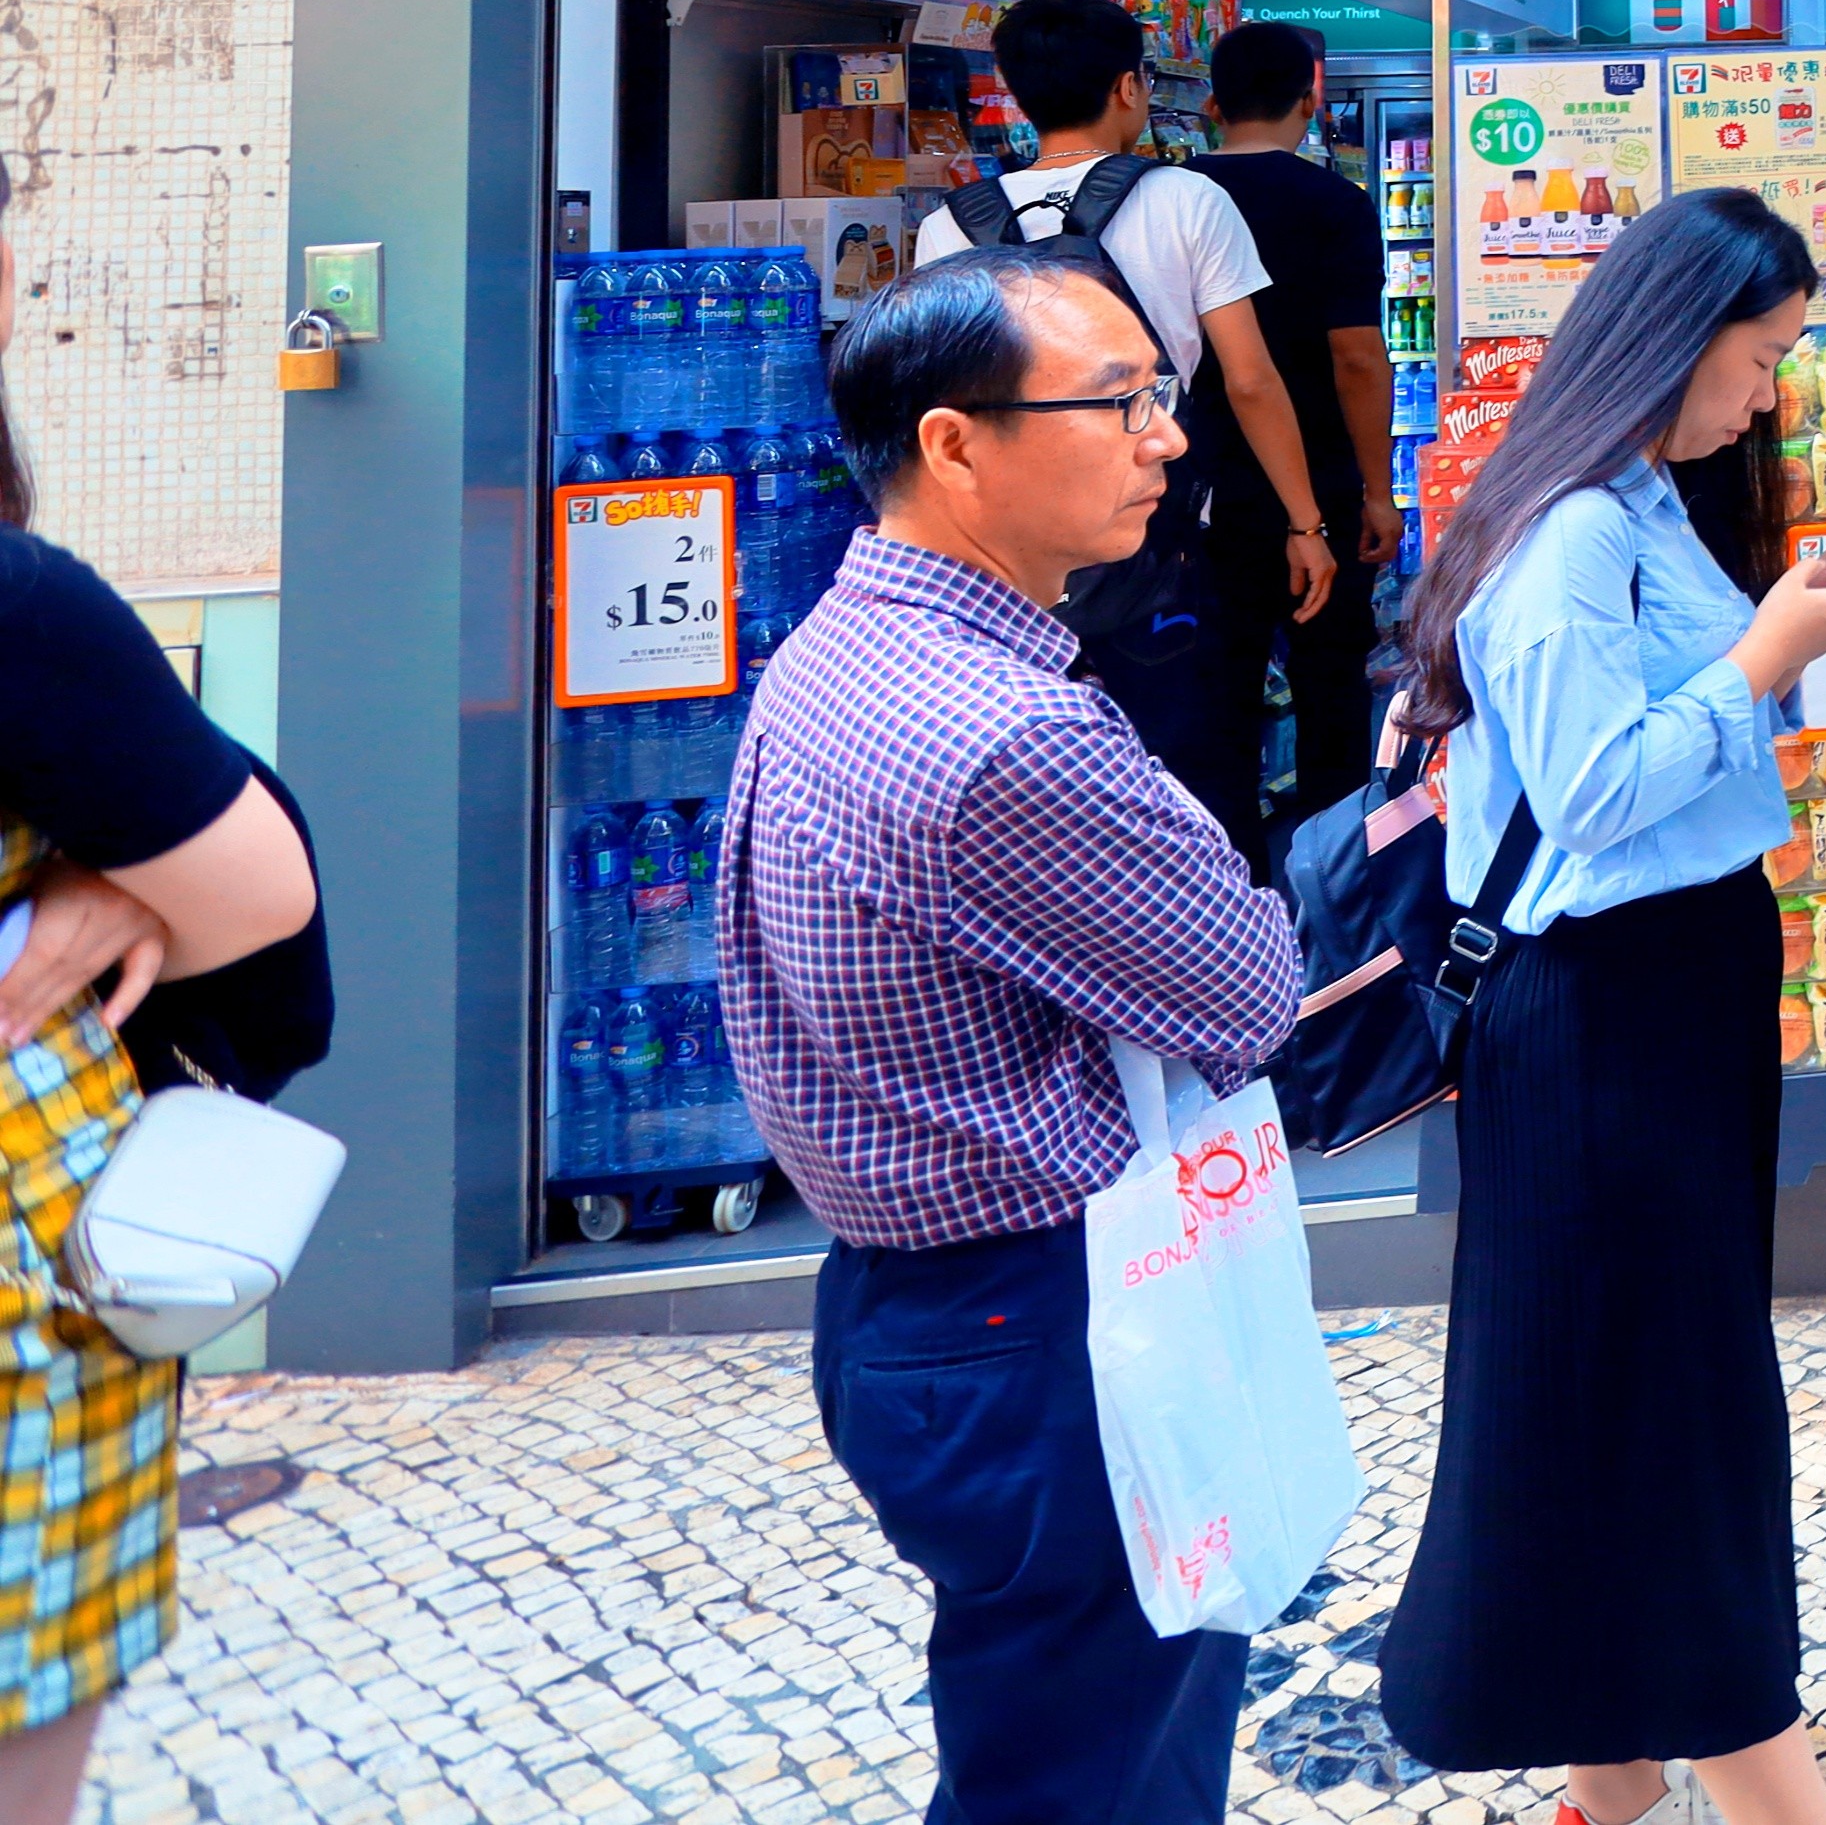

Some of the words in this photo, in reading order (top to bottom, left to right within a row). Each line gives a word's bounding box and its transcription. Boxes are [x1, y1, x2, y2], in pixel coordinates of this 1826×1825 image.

[1260, 8, 1310, 20] Quench
[1312, 8, 1341, 19] Your
[1343, 7, 1381, 19] Thirst
[1610, 65, 1636, 76] DELI
[1610, 75, 1638, 85] FRESH
[1732, 59, 1820, 82] 限量優惠
[1682, 97, 1771, 119] 購物滿$50
[1475, 121, 1537, 154] $10
[1723, 128, 1741, 146] 送
[630, 310, 678, 321] Bonaqua
[695, 309, 742, 319] Bonaqua
[1465, 343, 1543, 386] Maltesers
[1444, 399, 1518, 445] Maltese
[674, 535, 694, 563] 2
[698, 545, 719, 563] 件
[606, 581, 719, 630] $15.0
